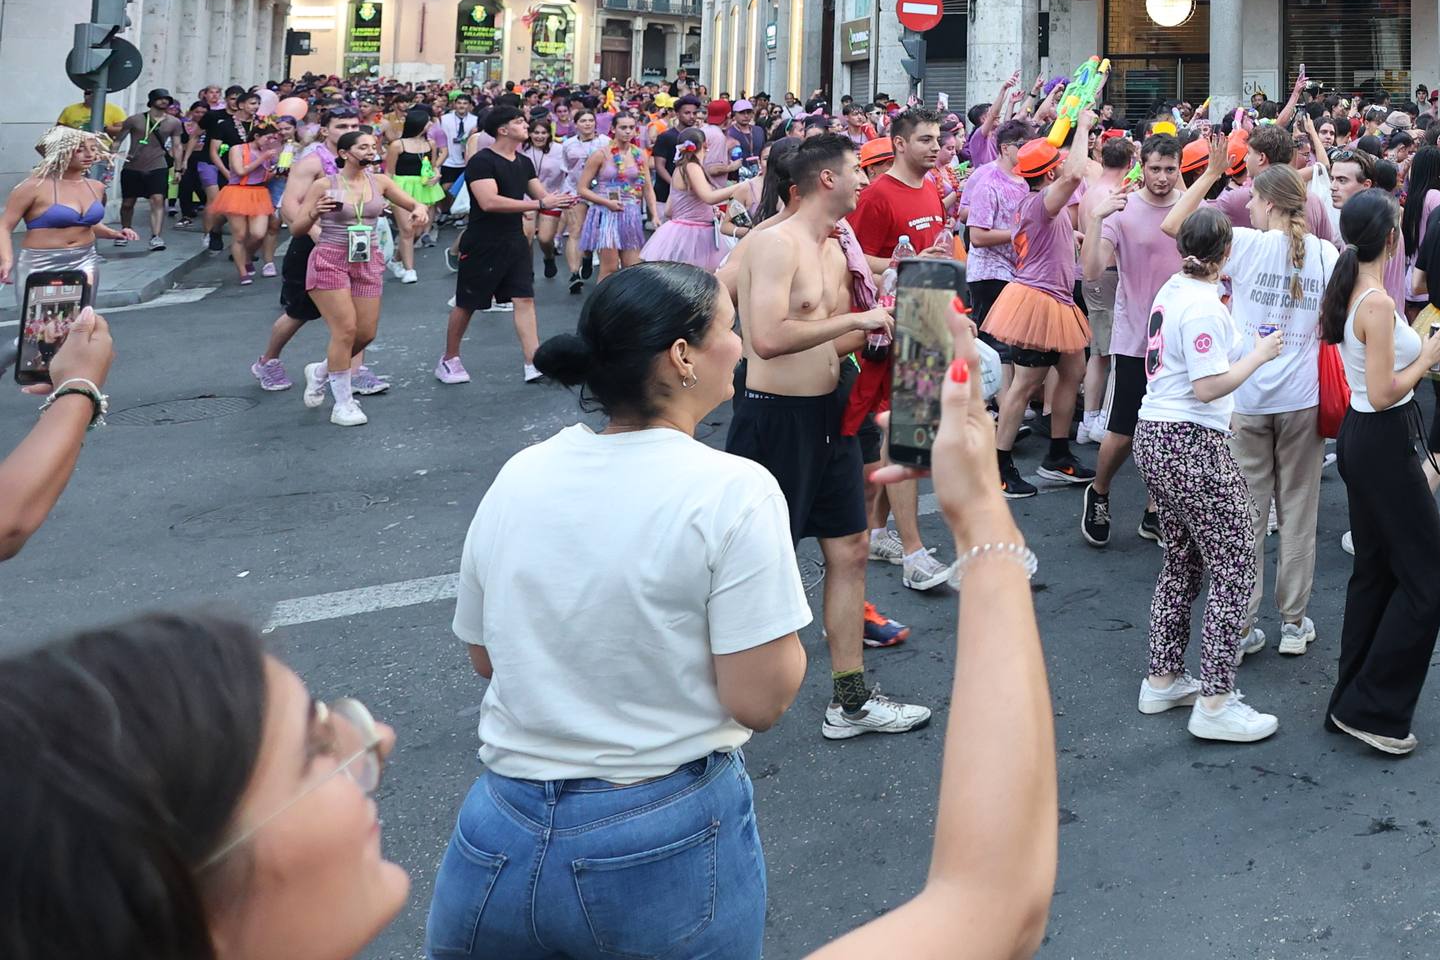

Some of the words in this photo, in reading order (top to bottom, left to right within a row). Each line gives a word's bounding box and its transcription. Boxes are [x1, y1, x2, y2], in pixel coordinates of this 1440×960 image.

[1254, 272, 1282, 289] SAINT
[1283, 275, 1320, 293] MCHEL
[1250, 289, 1280, 307] ROBERT
